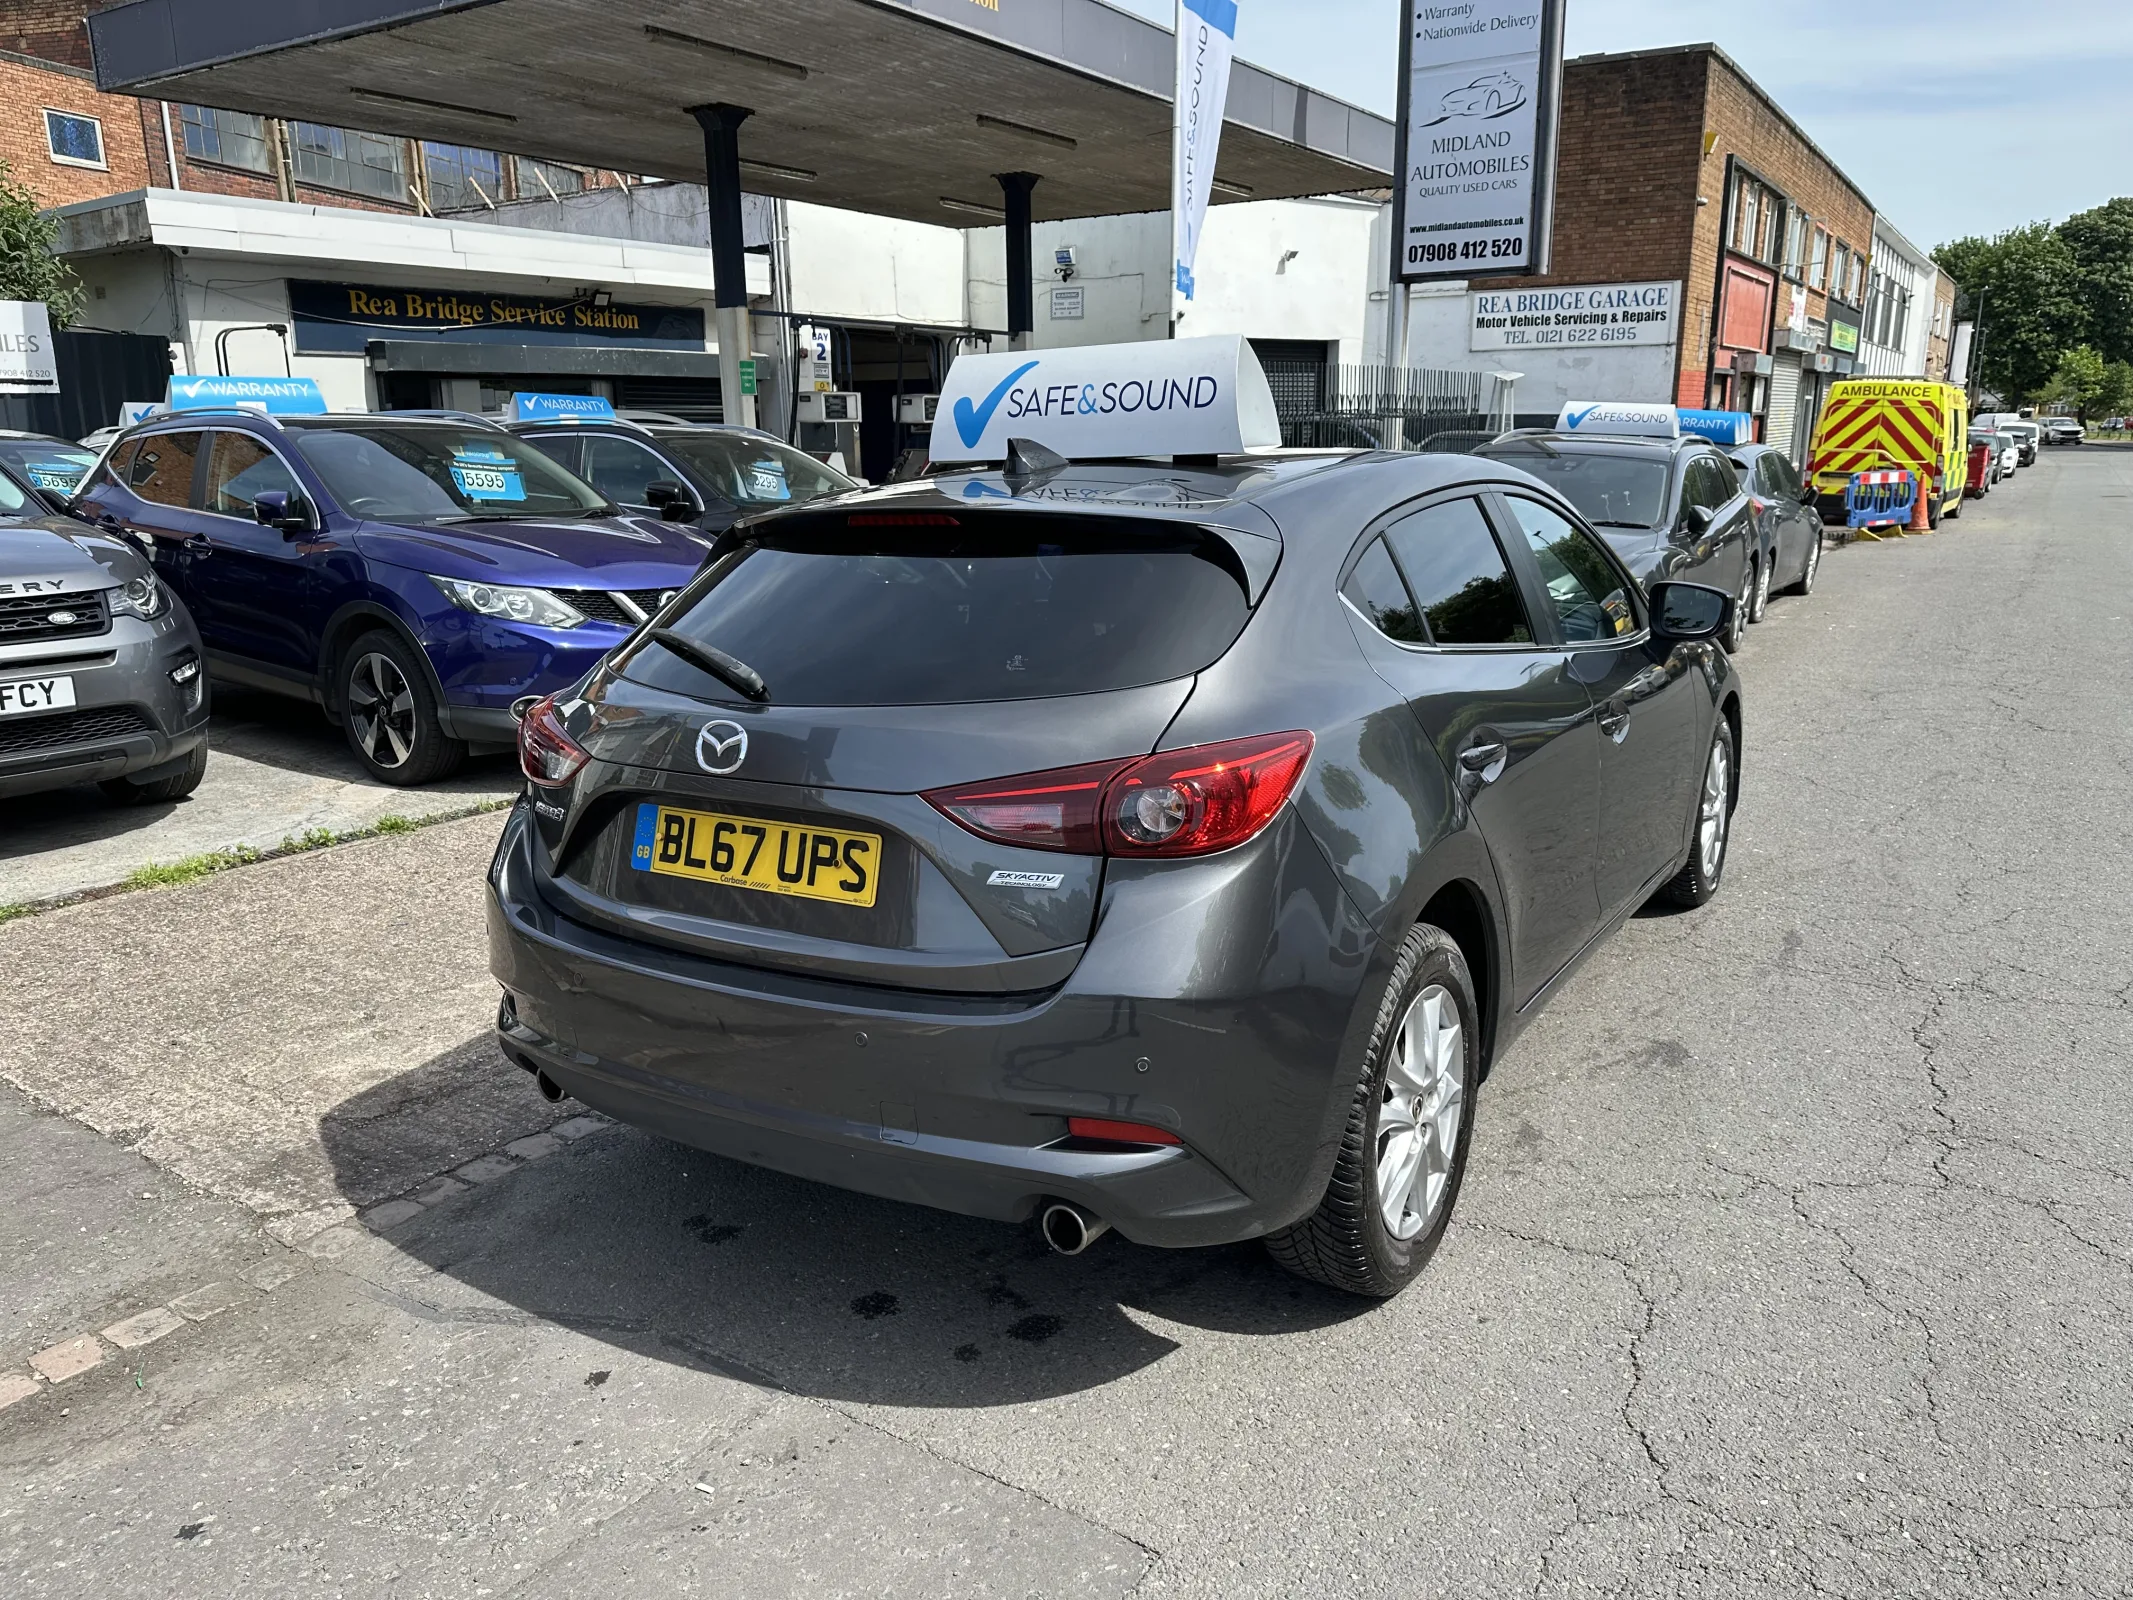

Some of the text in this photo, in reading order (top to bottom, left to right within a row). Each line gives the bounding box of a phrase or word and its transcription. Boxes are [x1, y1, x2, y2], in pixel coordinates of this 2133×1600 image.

[1424, 3, 1475, 20] Warranty
[1423, 13, 1539, 41] Nationwide Delivery
[1431, 130, 1511, 154] MIDLAND
[1411, 154, 1530, 181] AUTOMOBILES
[1419, 178, 1518, 198] QUALITY USED CARS
[1409, 216, 1524, 234] www.midlandautomobiles.co.uk
[1408, 237, 1522, 263] 07908 412 520
[349, 290, 640, 330] Rea Bridge Service Station
[1478, 287, 1669, 314] REA BRIDGE GARAGE
[1476, 309, 1667, 329] Motor Vehicle Servicing & Repairs
[1504, 326, 1637, 345] TEL. 0121 622 6195
[816, 342, 827, 361] 2
[35, 369, 51, 378] 520
[208, 381, 309, 397] WARRANTY
[1007, 376, 1217, 418] SAFE&SOUND
[1840, 385, 1932, 398] AMBULANCE
[540, 397, 605, 412] WARRANTY
[1588, 411, 1668, 424] SAFE&SOUND
[0, 580, 64, 594] ERY
[636, 845, 650, 859] GB
[659, 813, 870, 894] BL67 UPS
[720, 874, 748, 887] Carbase
[996, 872, 1056, 882] SKYACTIV
